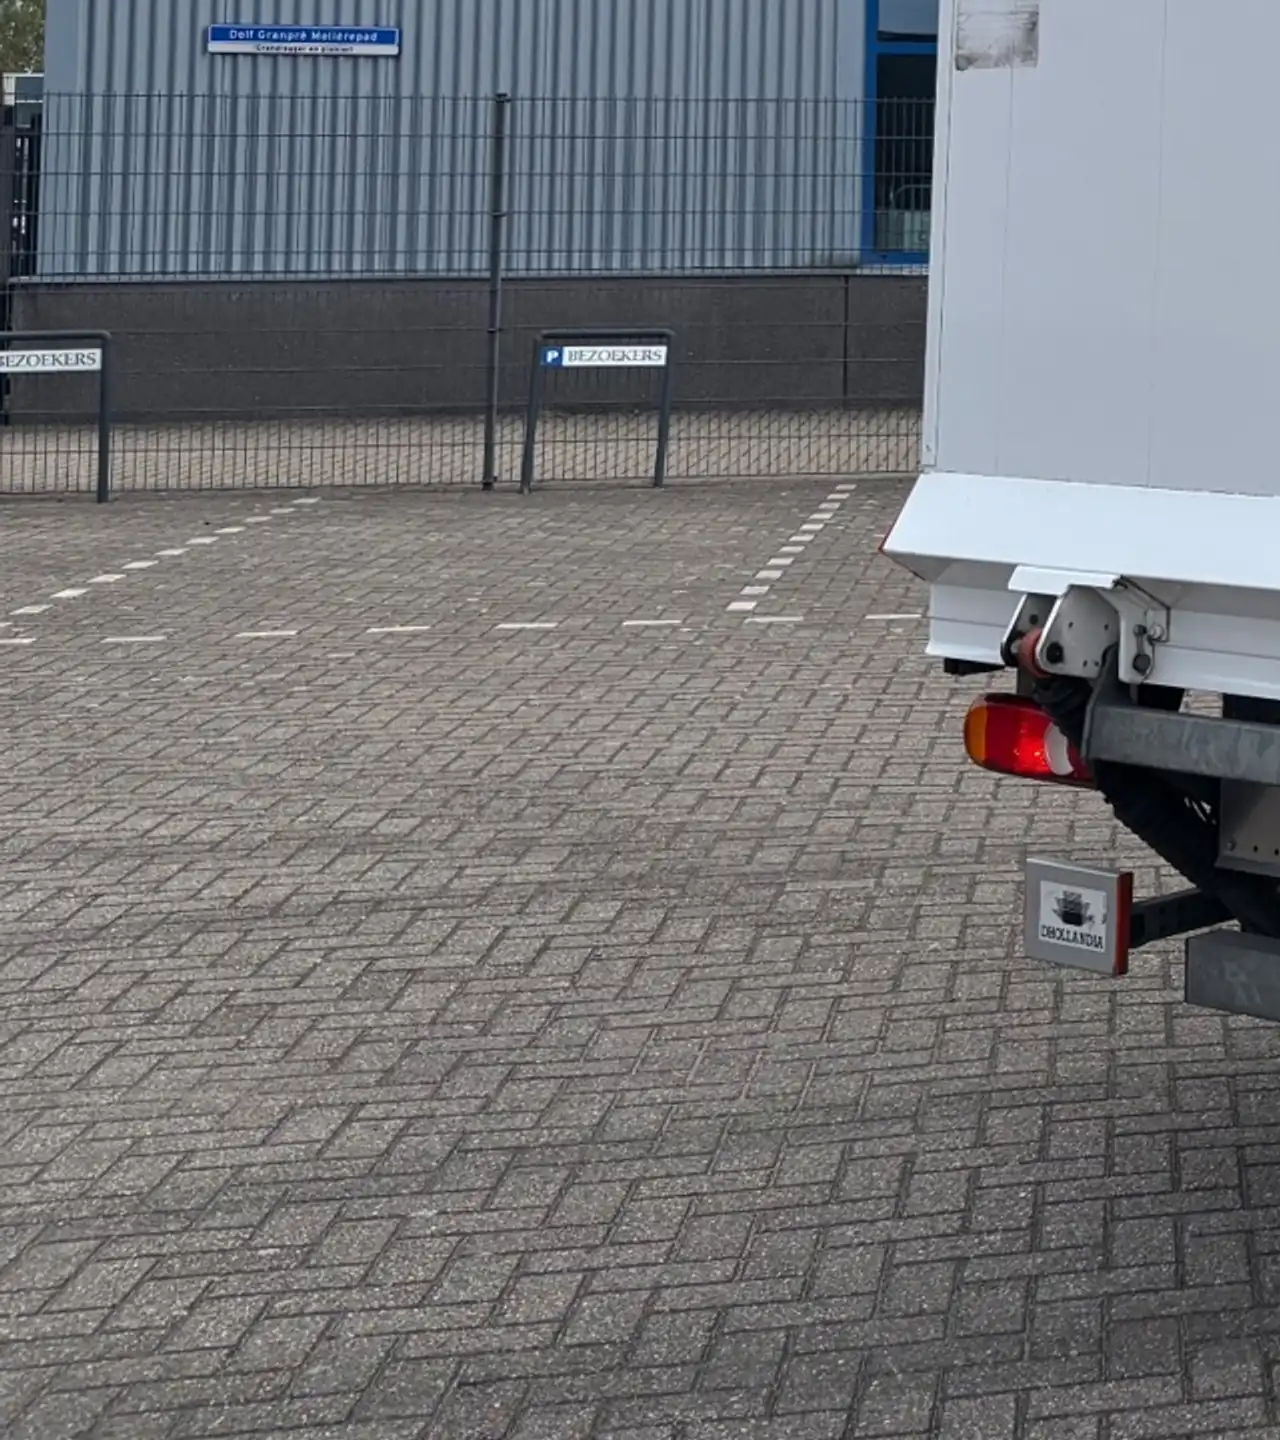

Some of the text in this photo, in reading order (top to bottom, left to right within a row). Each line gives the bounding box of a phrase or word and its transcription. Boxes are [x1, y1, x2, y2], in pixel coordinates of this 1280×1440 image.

[546, 349, 663, 363] P BEZOEKERS
[1041, 924, 1104, 949] DHOLLANDIA
